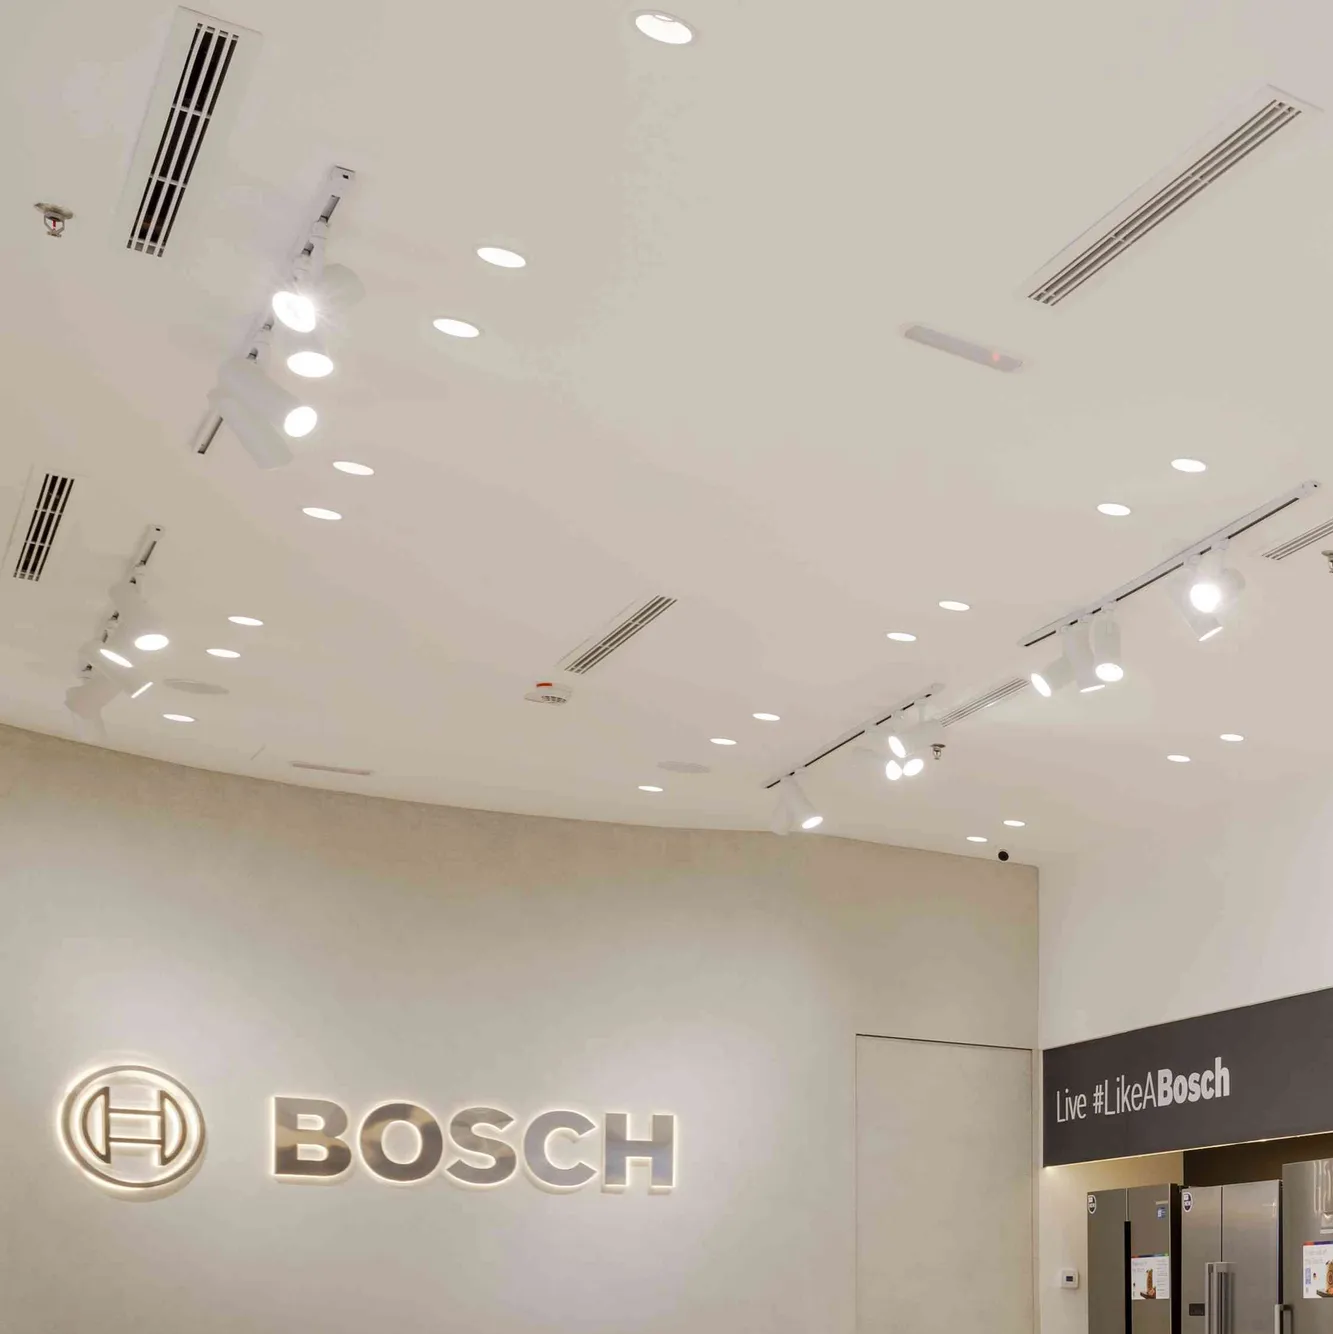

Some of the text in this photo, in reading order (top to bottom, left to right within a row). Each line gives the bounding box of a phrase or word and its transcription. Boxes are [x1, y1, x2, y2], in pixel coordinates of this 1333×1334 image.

[1056, 1056, 1230, 1123] Live #LikeABosch
[274, 1096, 676, 1188] BOSCH
